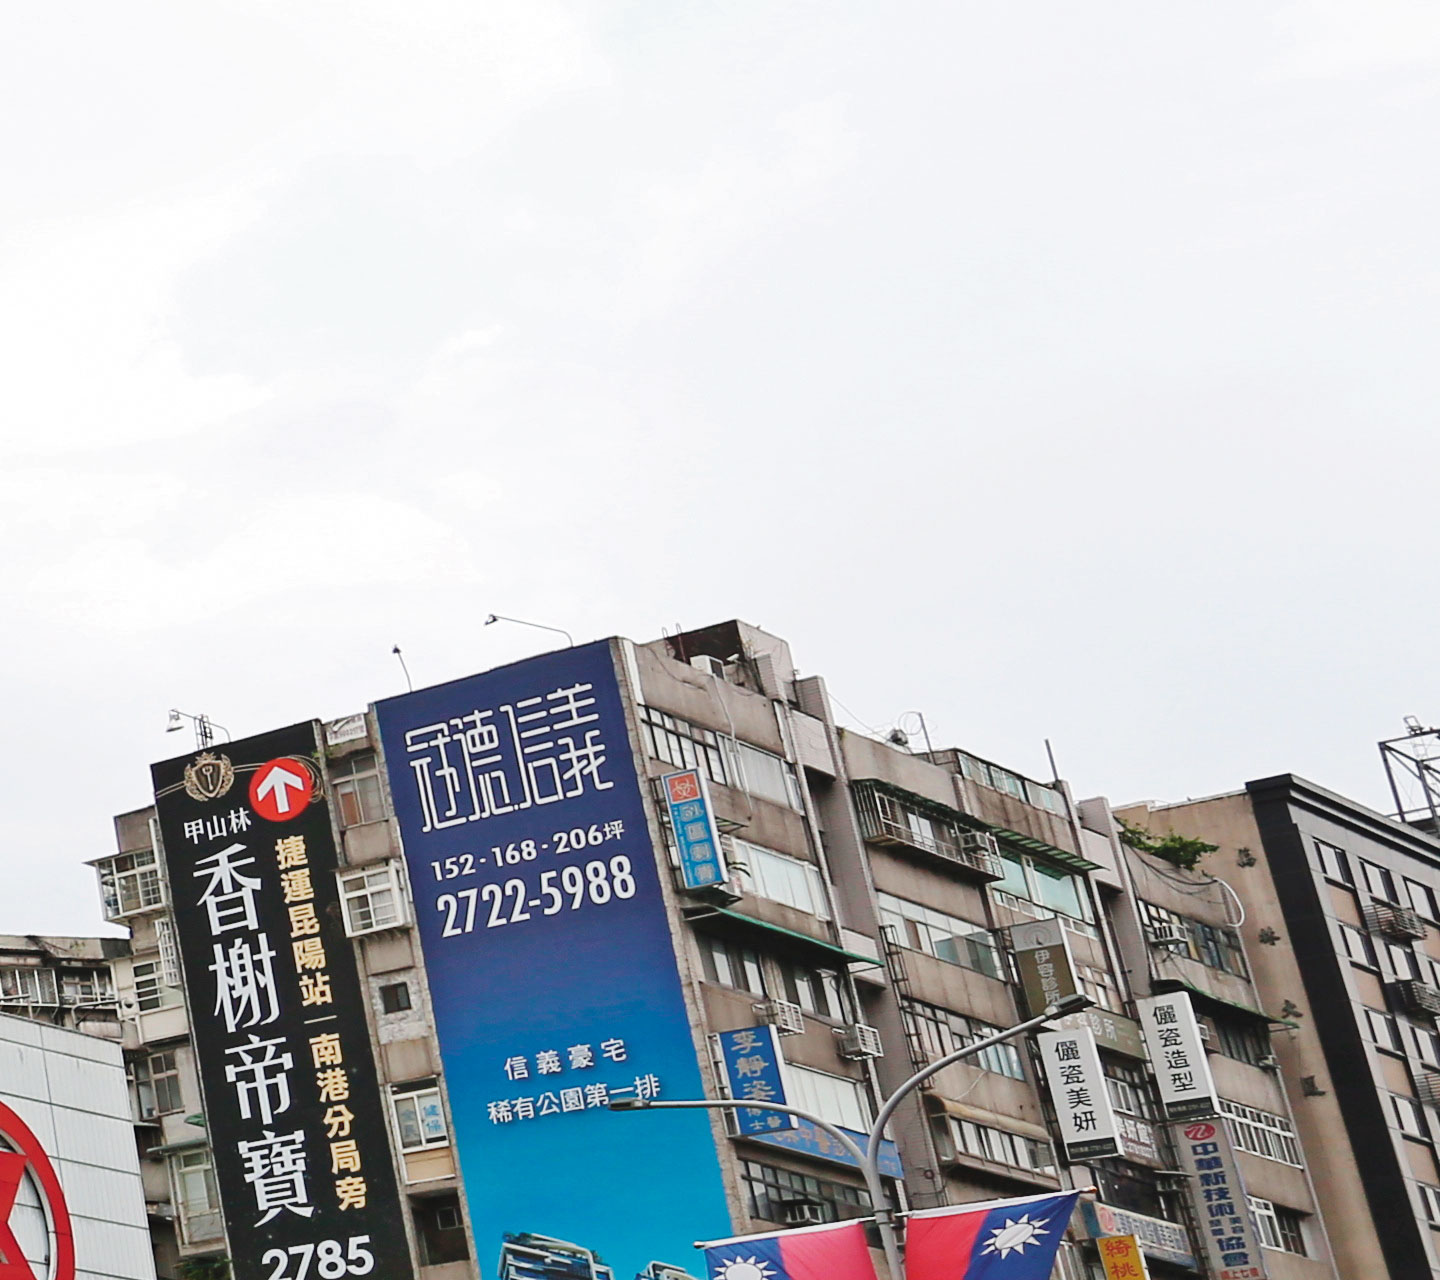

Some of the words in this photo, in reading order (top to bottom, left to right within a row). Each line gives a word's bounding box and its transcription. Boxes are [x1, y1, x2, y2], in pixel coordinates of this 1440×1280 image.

[184, 808, 252, 846] 甲山林
[436, 855, 637, 938] 2722-5988
[192, 842, 317, 1228] 香榭帝寶
[504, 1038, 628, 1080] 信義豪宅
